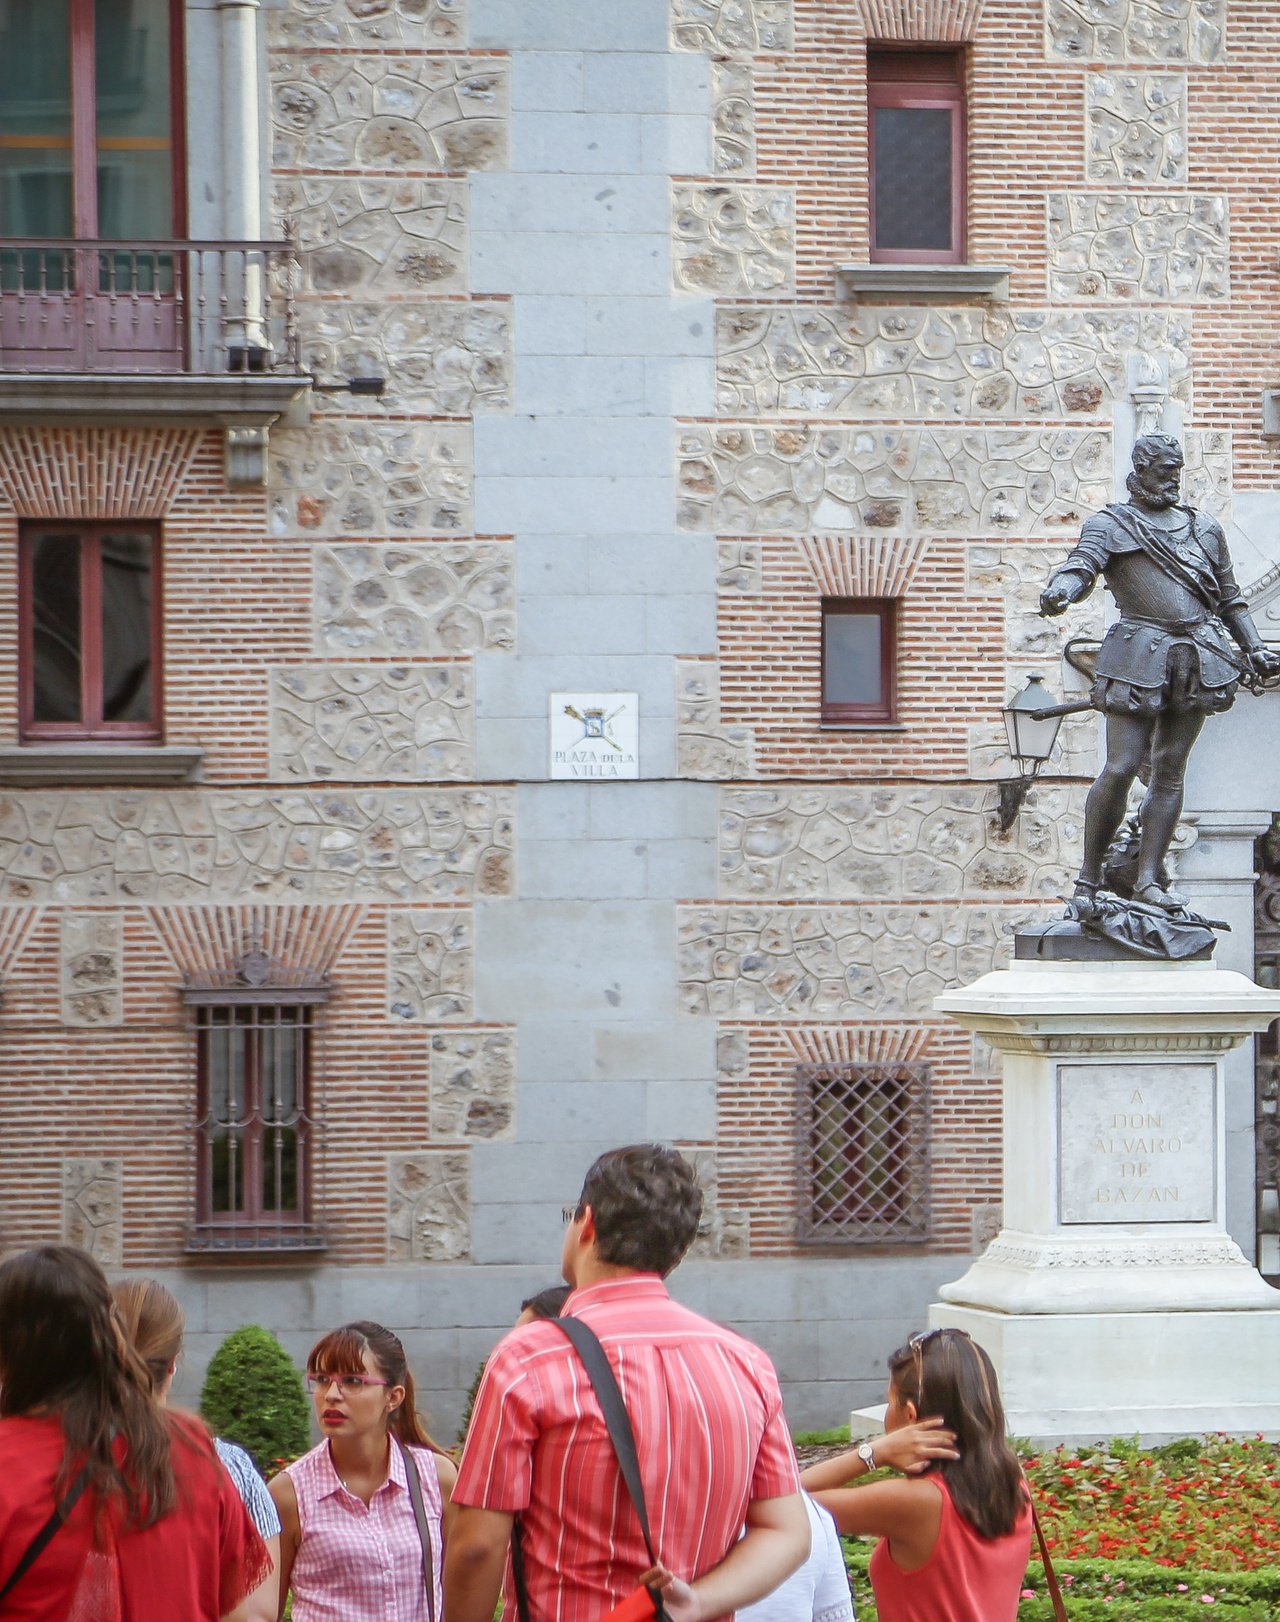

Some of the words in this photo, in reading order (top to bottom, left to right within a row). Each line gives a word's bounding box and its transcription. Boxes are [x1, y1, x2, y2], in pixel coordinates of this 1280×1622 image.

[555, 751, 597, 763] PLAZA
[602, 754, 617, 763] DE
[619, 754, 635, 763] LA
[571, 765, 619, 777] VILLA
[1130, 1089, 1144, 1105] A
[1112, 1113, 1163, 1129] DON
[1094, 1137, 1182, 1154] ALVARO
[1120, 1162, 1152, 1178] DE
[1095, 1186, 1180, 1203] BAZAN
